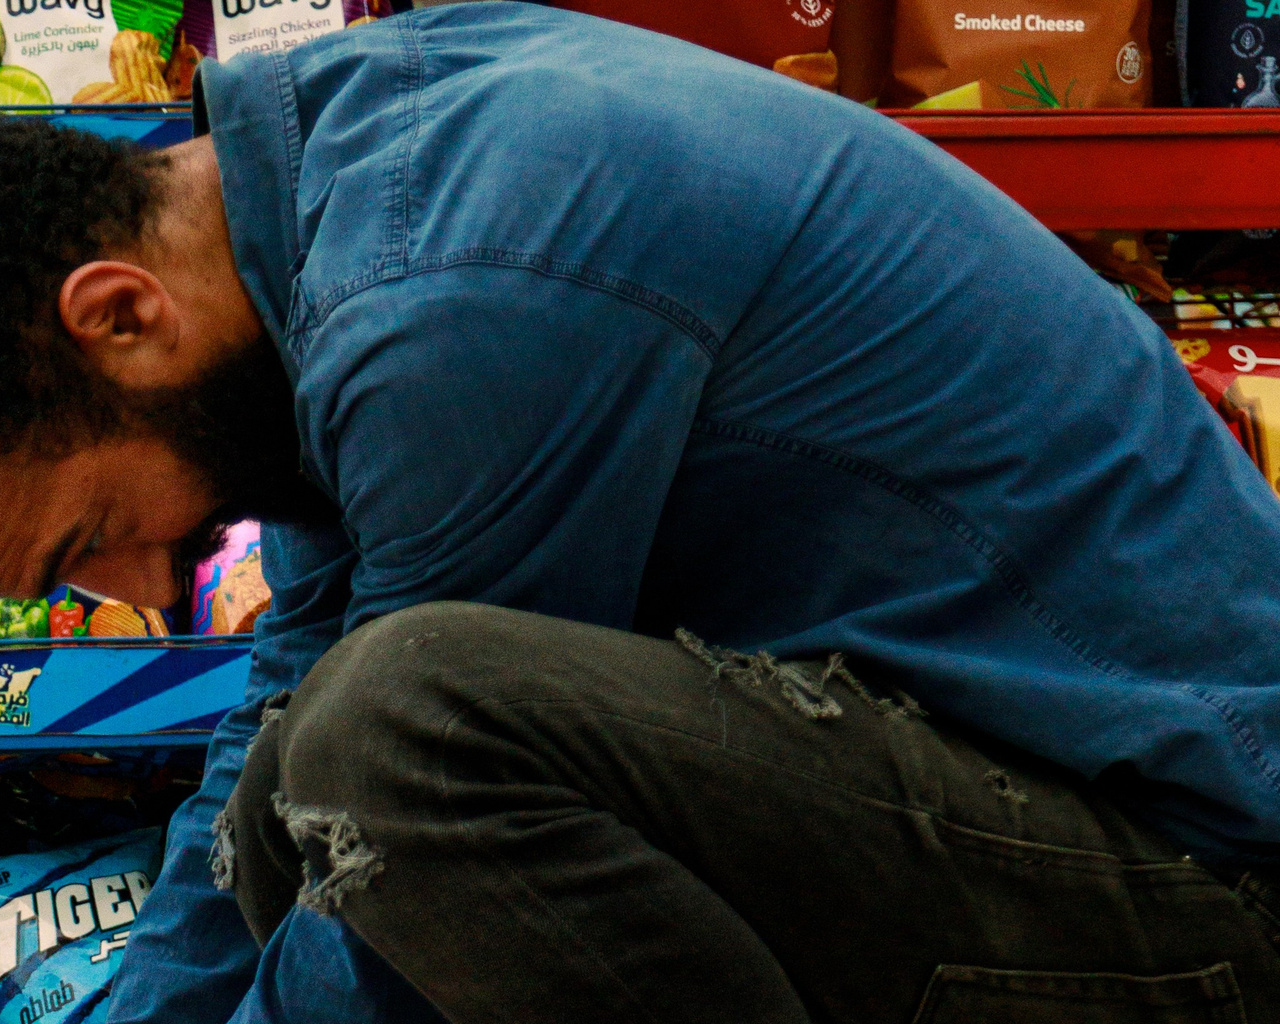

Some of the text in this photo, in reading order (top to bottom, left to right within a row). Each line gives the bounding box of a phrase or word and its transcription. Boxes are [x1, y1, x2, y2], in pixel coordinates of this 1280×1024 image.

[14, 24, 105, 42] Lime Coriander
[228, 17, 331, 46] Sizzling Chicken
[953, 12, 1085, 33] Smoked Cheese
